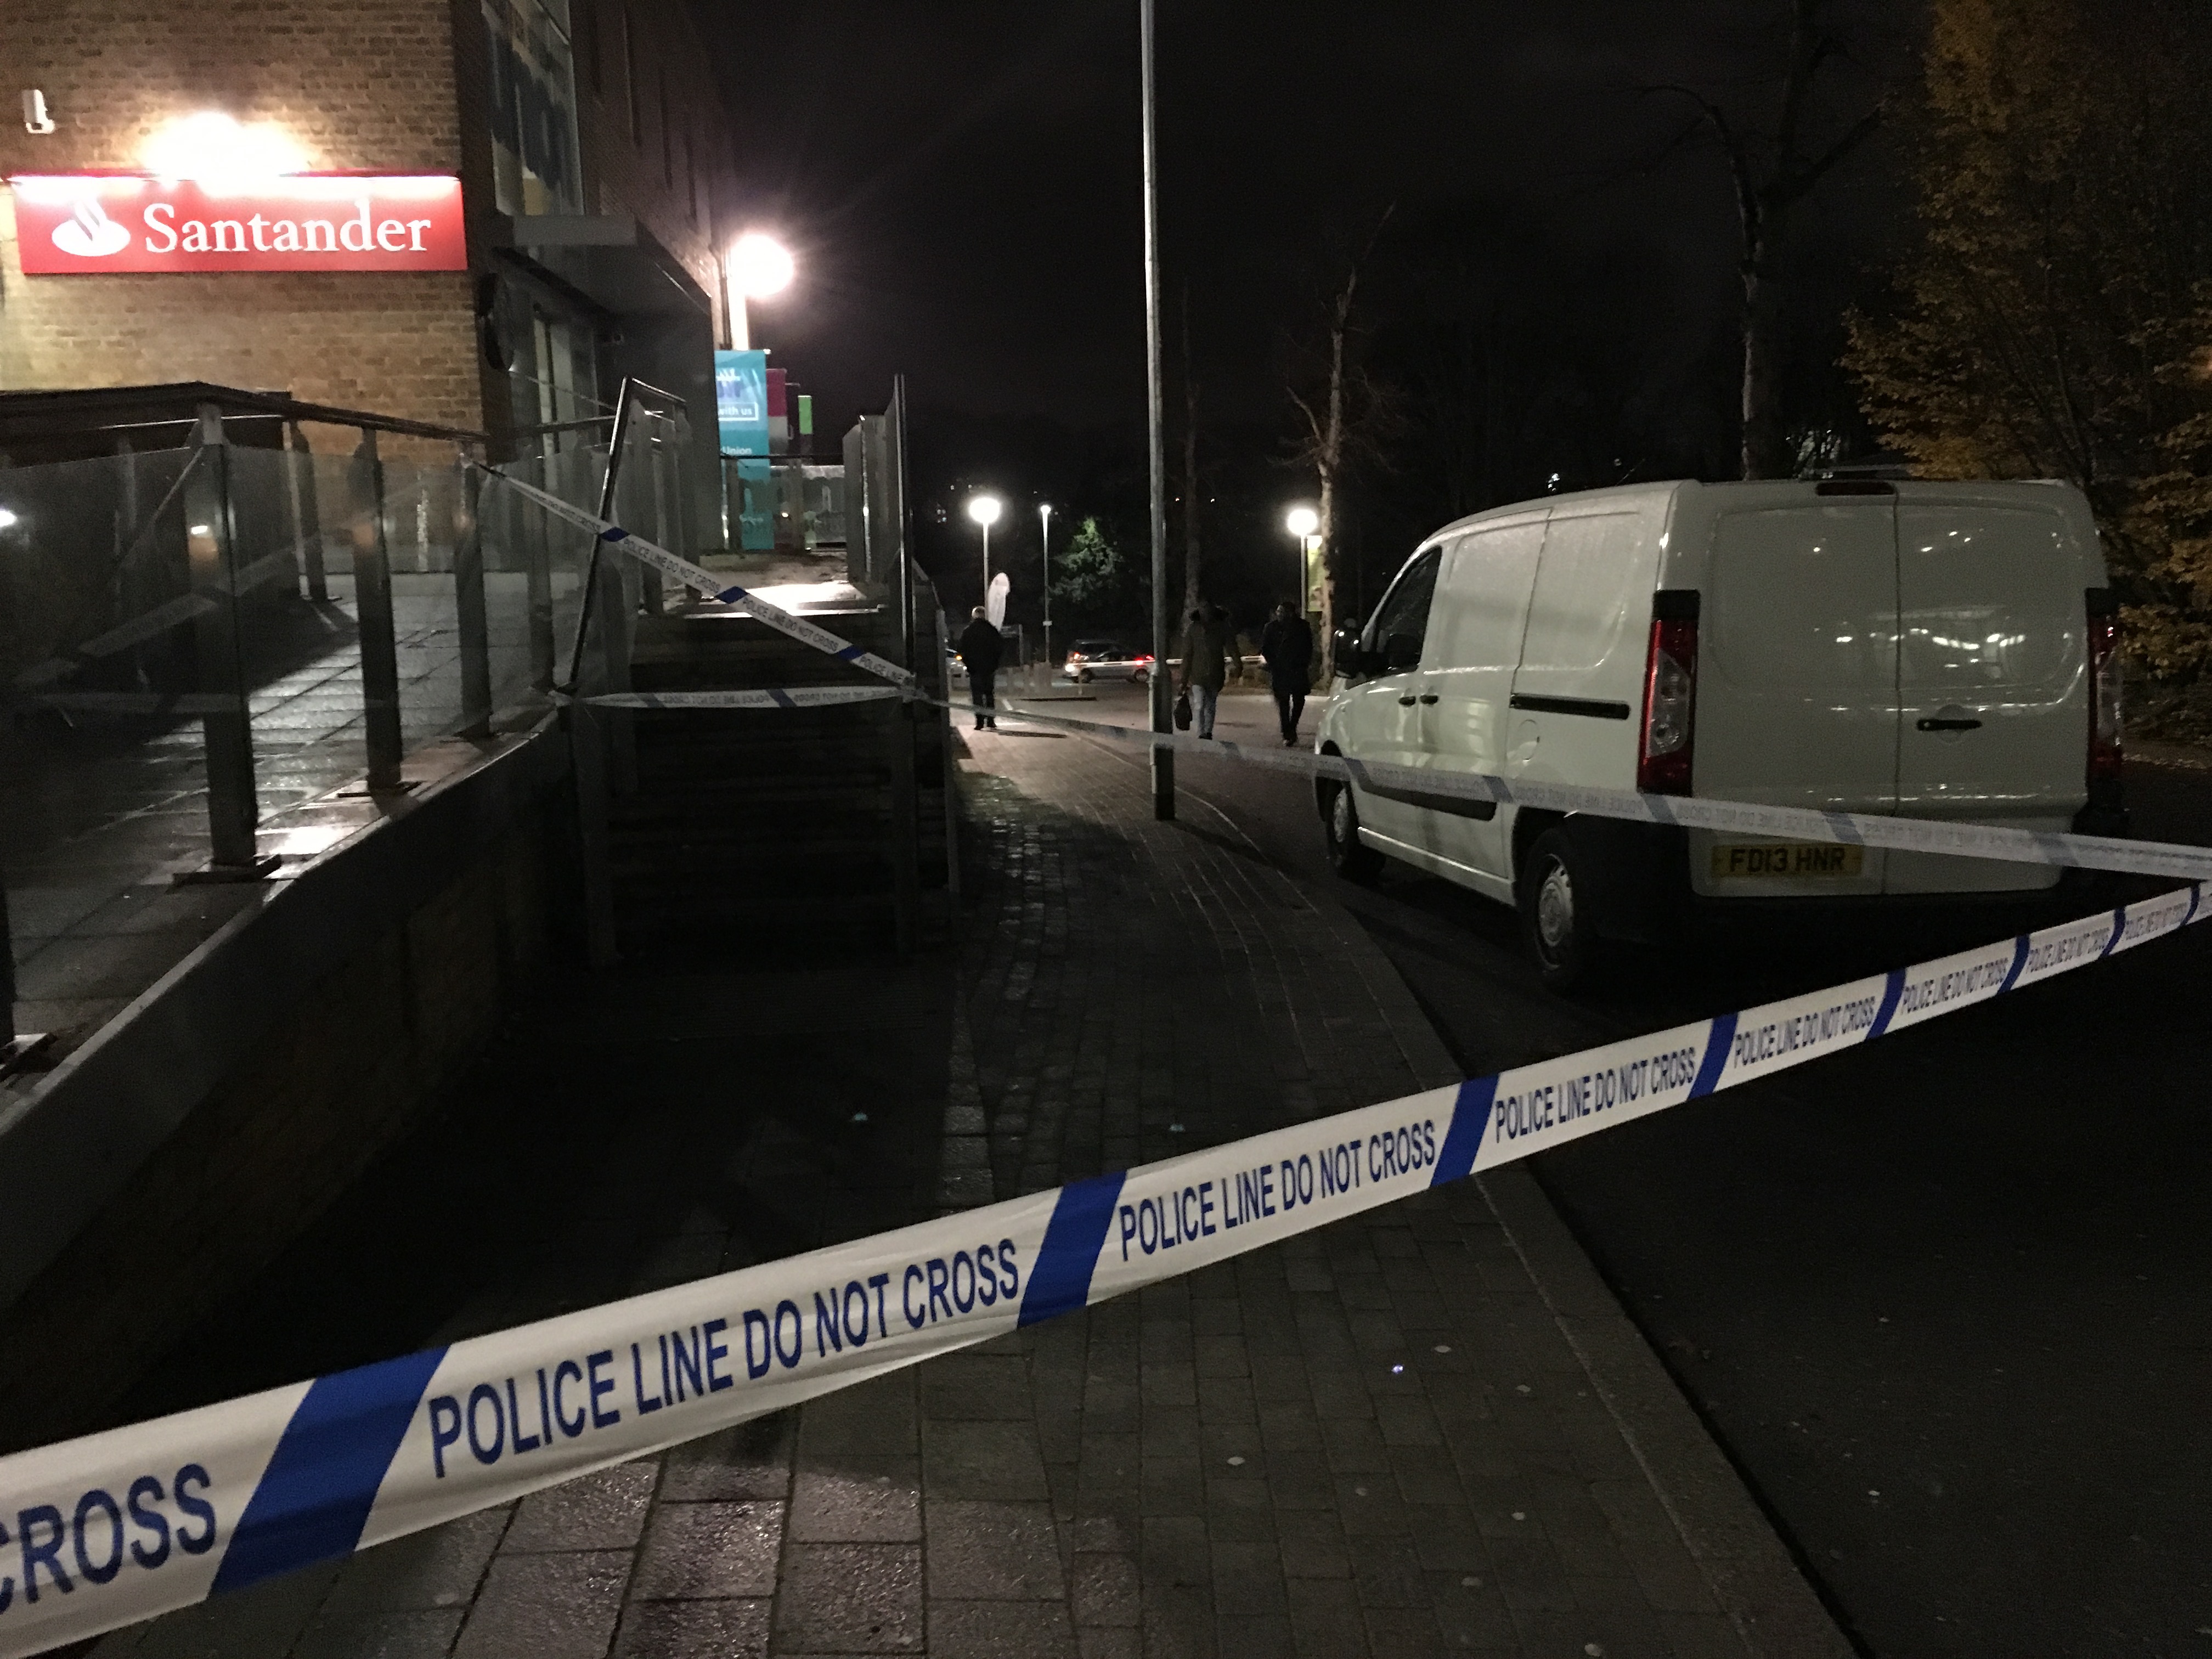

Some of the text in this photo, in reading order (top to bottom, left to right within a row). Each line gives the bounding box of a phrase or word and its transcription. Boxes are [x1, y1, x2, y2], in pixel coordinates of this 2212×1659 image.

[143, 197, 431, 253] Santander
[1730, 847, 1846, 873] FD13 HNR
[1495, 1047, 1696, 1144] POLICE LINE DO NOT CROSS
[1120, 1119, 1436, 1262] POLICE LINE DO NOT CROSS
[428, 1238, 1019, 1479] POLICE LINE DO NOT CROSS
